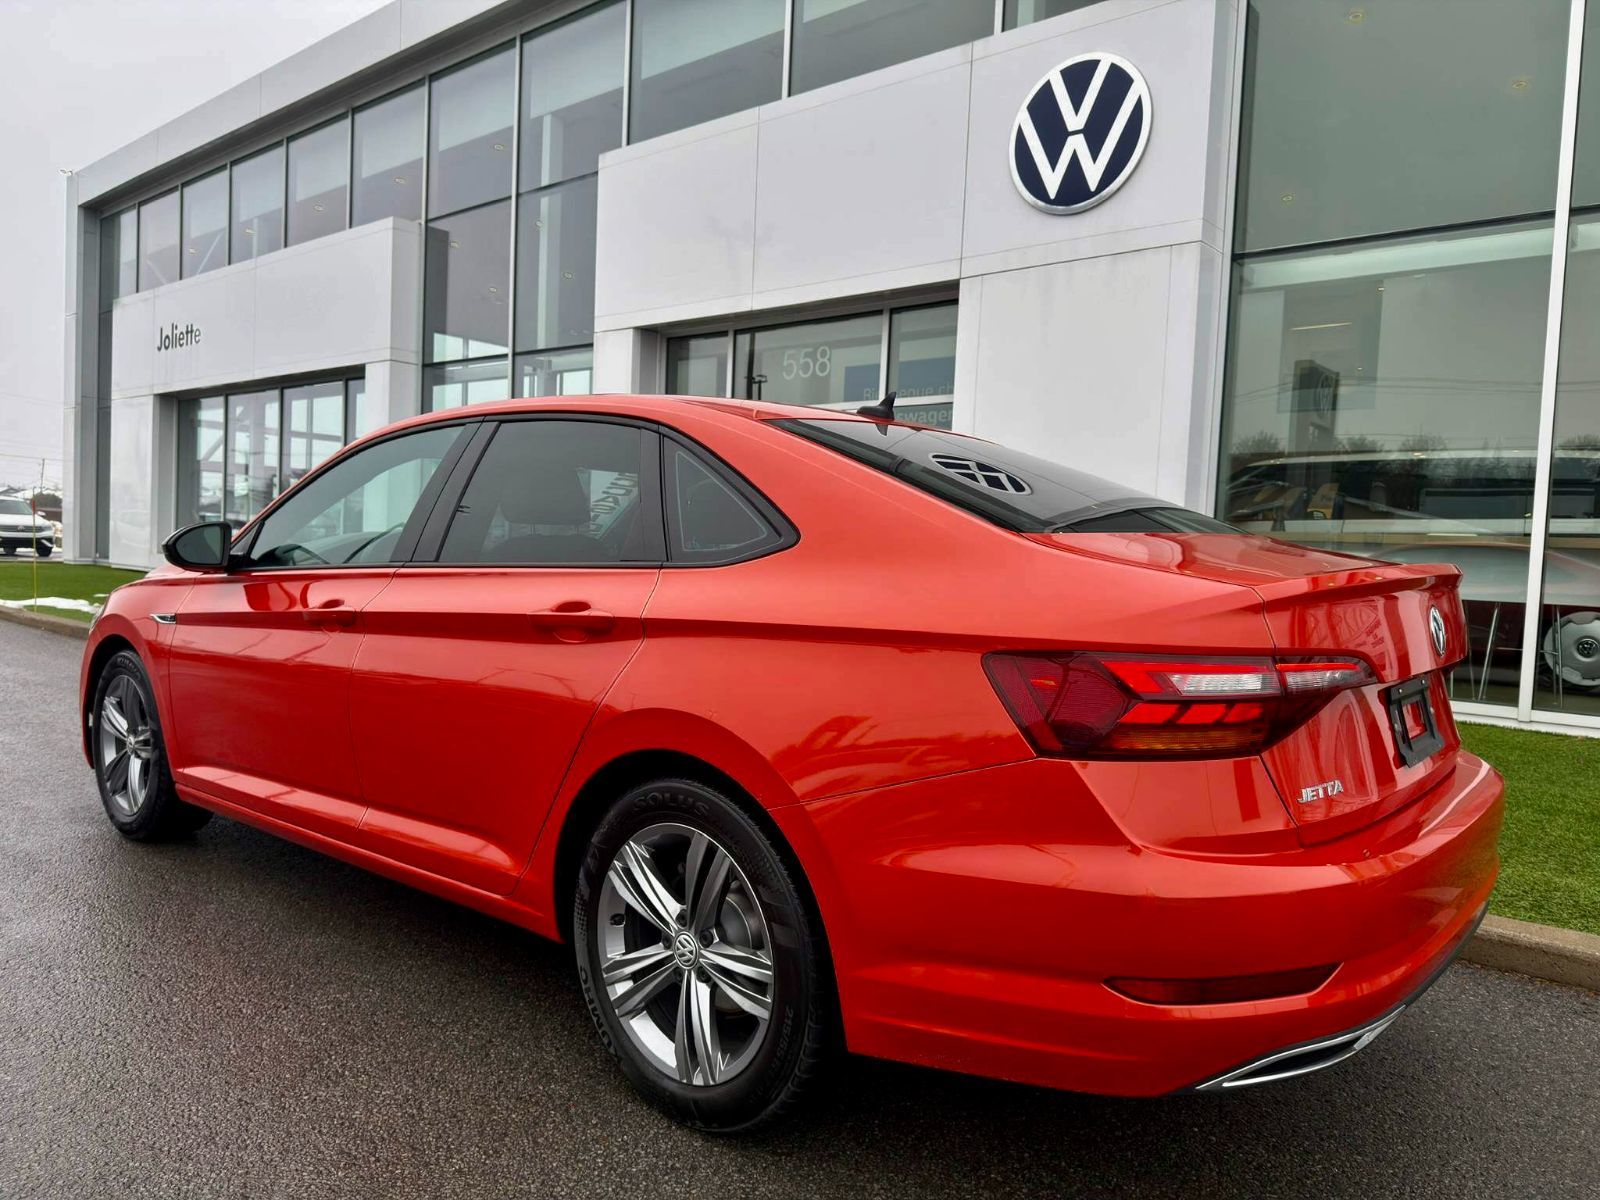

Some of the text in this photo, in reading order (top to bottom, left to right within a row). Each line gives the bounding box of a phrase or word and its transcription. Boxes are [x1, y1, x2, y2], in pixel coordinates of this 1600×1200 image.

[1009, 52, 1153, 214] VW
[157, 322, 201, 352] Joliette
[782, 345, 832, 381] 558
[632, 791, 711, 817] SOLUS
[1296, 779, 1344, 803] JETTA
